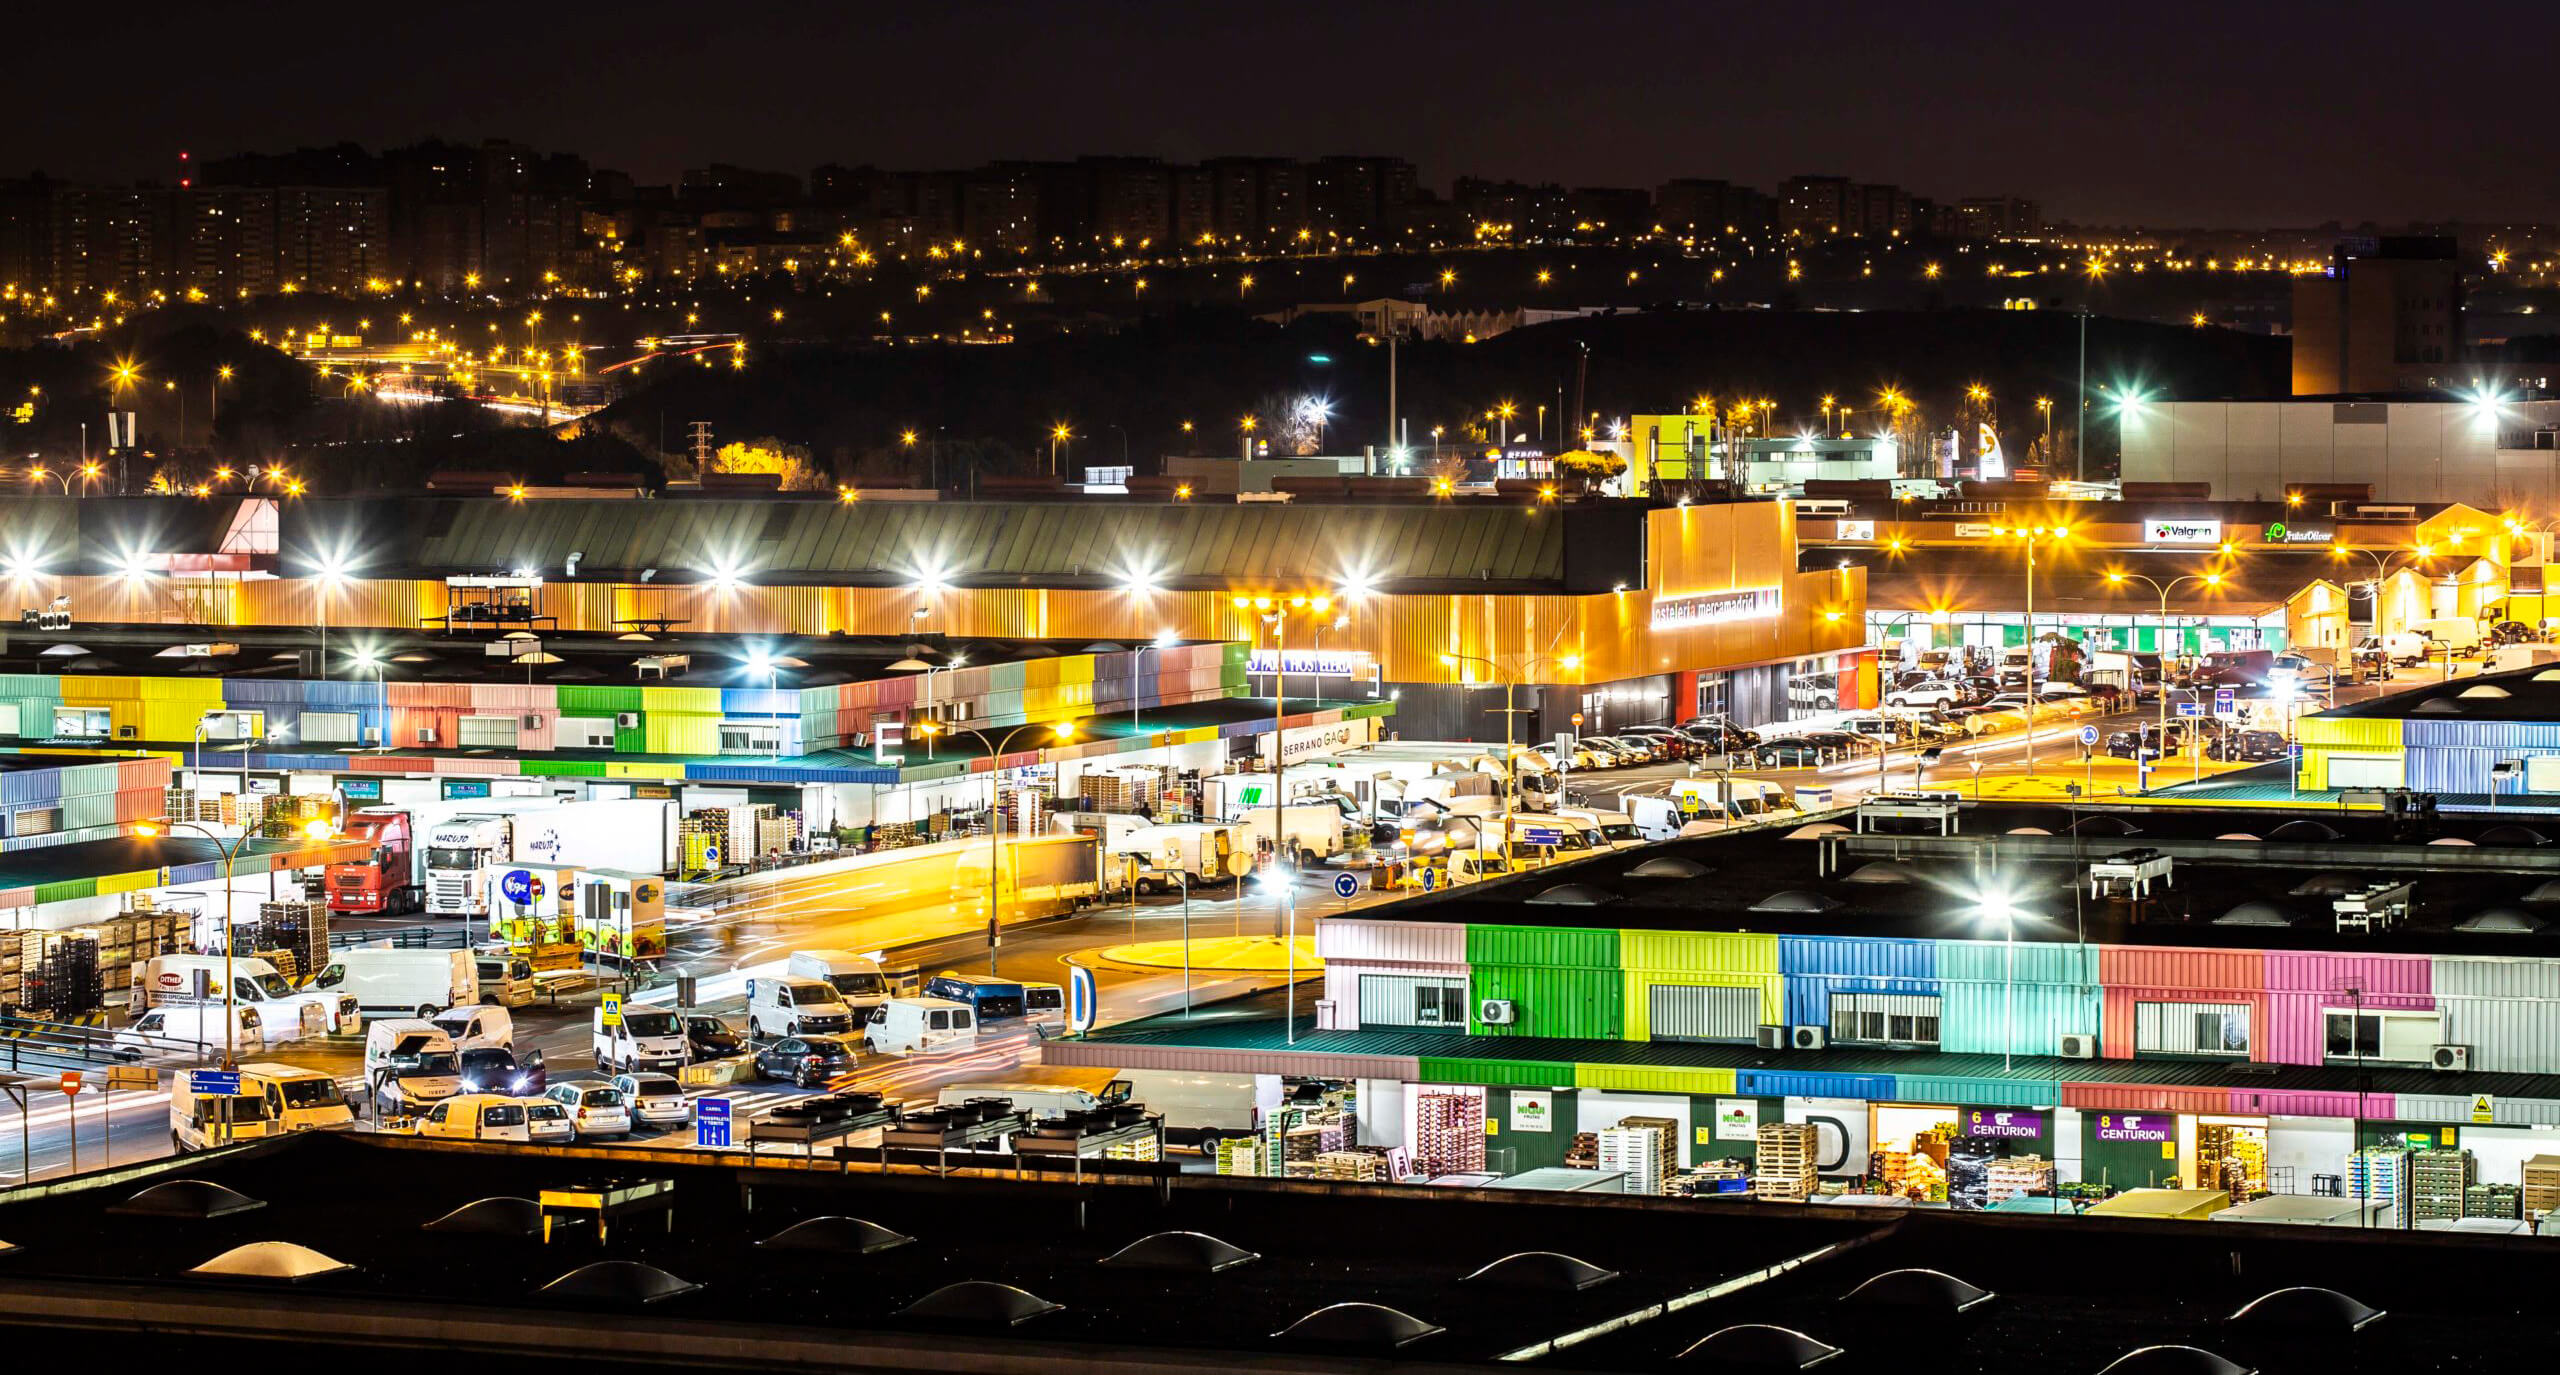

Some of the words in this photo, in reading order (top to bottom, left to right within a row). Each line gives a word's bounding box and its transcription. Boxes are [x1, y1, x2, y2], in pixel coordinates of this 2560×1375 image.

[1283, 737, 1323, 757] SERRANO
[436, 834, 469, 843] MARUJO
[530, 840, 554, 851] MARUJO
[1071, 966, 1097, 1032] D
[1972, 1112, 1982, 1124] 6
[2101, 1115, 2111, 1128] 8
[1972, 1125, 2036, 1137] CENTURION
[2101, 1129, 2165, 1140] CENTURION
